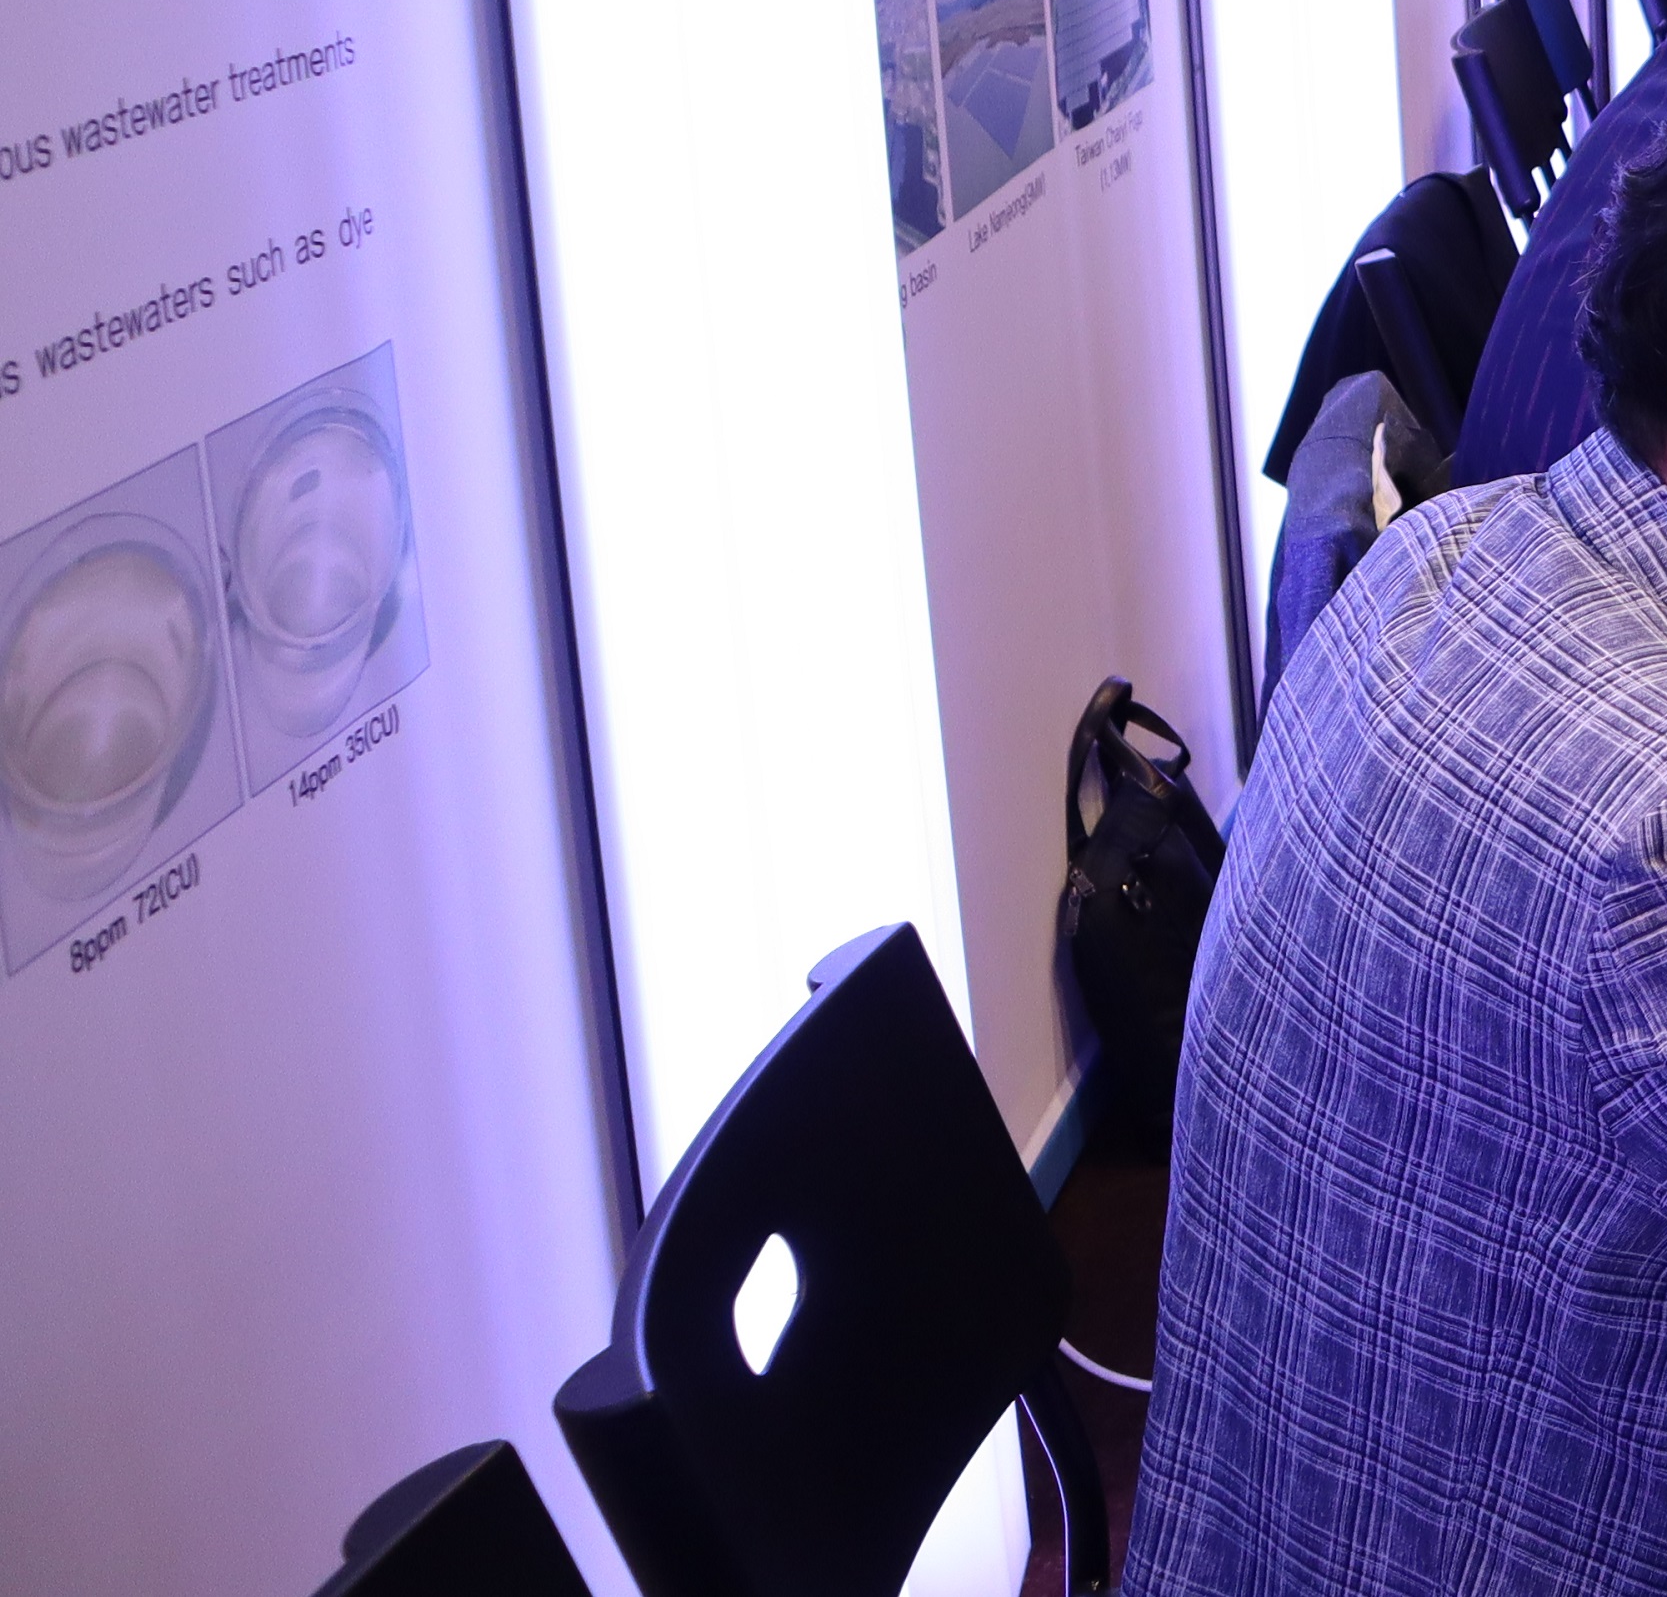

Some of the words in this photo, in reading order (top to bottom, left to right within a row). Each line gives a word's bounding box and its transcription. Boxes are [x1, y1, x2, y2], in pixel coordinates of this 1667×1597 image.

[60, 75, 221, 159] wastewater
[227, 29, 357, 103] treatments
[34, 273, 217, 379] wastewaters
[226, 237, 286, 297] such
[293, 227, 327, 266] as
[337, 205, 376, 250] dye
[909, 260, 939, 300] basin
[967, 220, 989, 254] Lake
[286, 753, 345, 808] 14ppm
[345, 702, 401, 765] 35(CU)
[68, 912, 130, 975] 8ppm
[131, 851, 202, 925] 72(CU)
